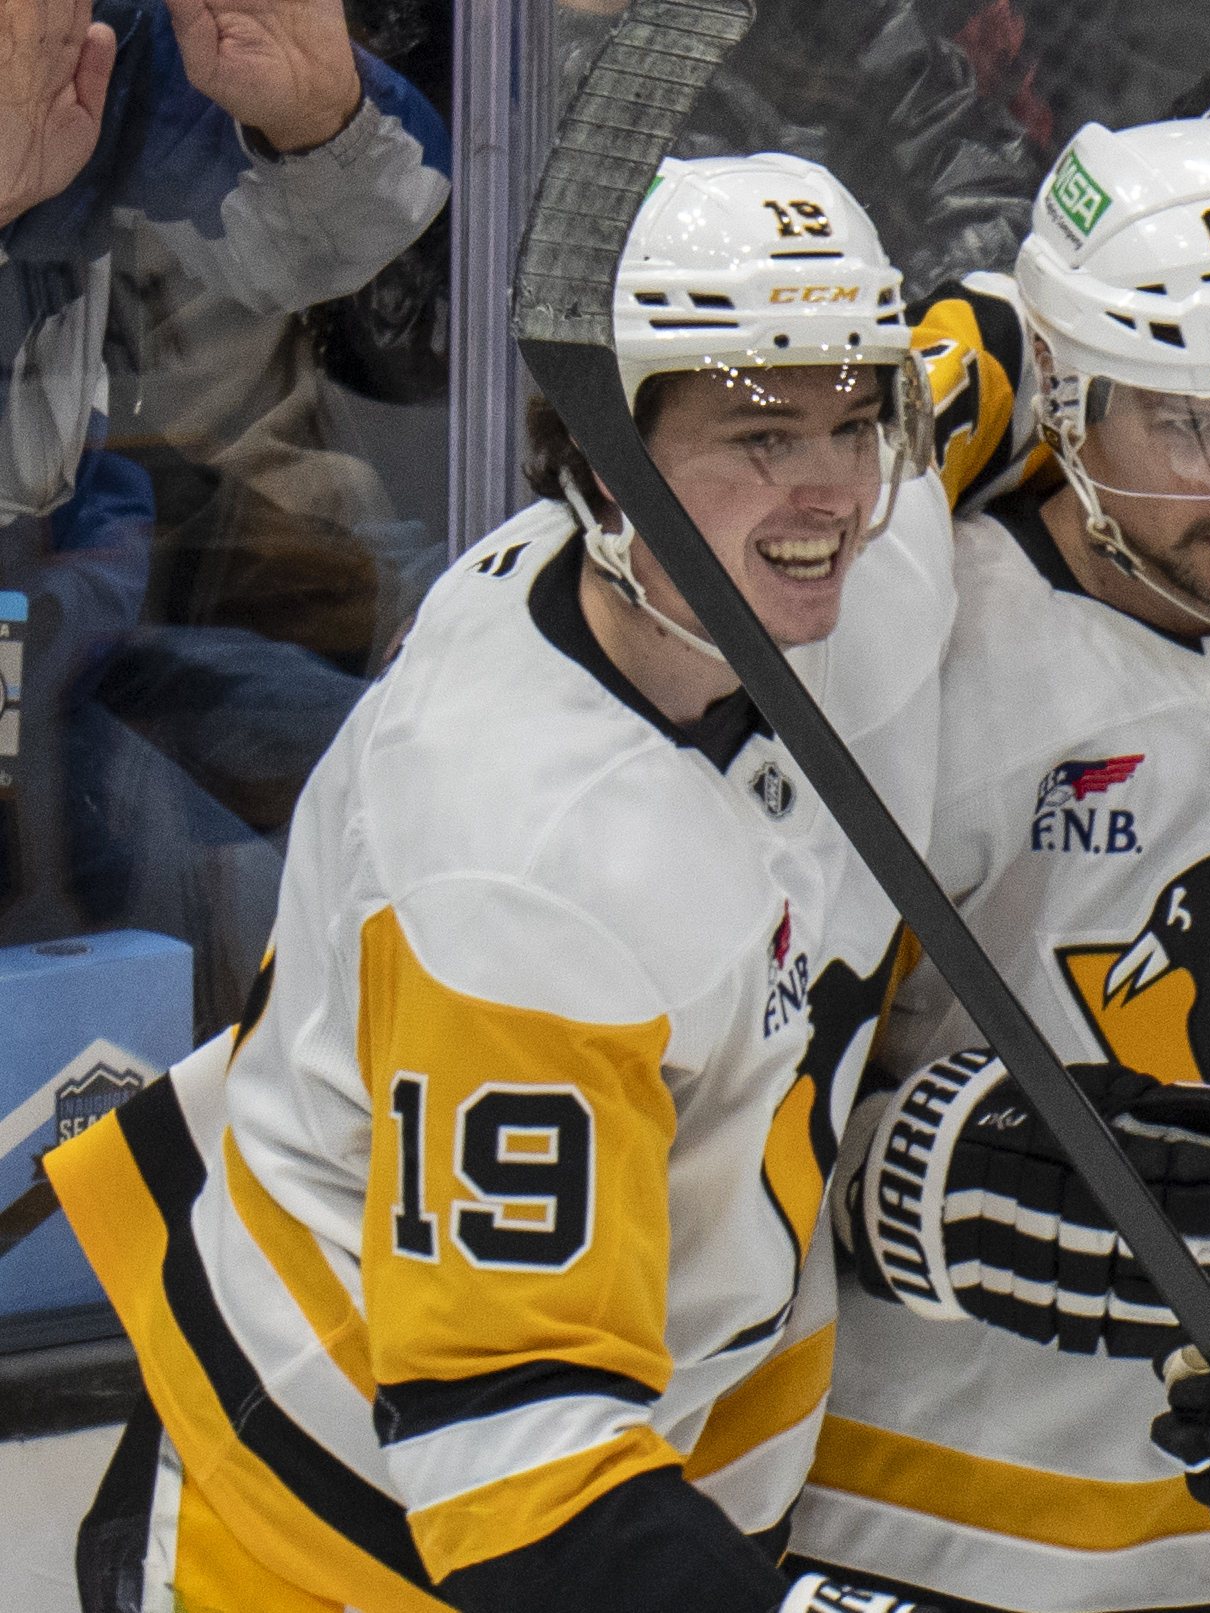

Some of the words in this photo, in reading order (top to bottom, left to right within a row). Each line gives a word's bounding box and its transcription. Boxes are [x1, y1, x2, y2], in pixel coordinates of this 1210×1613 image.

[763, 200, 832, 237] 19
[769, 286, 859, 303] CCM
[1031, 808, 1142, 854] F.N.B.
[390, 1069, 595, 1273] 19
[878, 1047, 991, 1303] WARRIO
